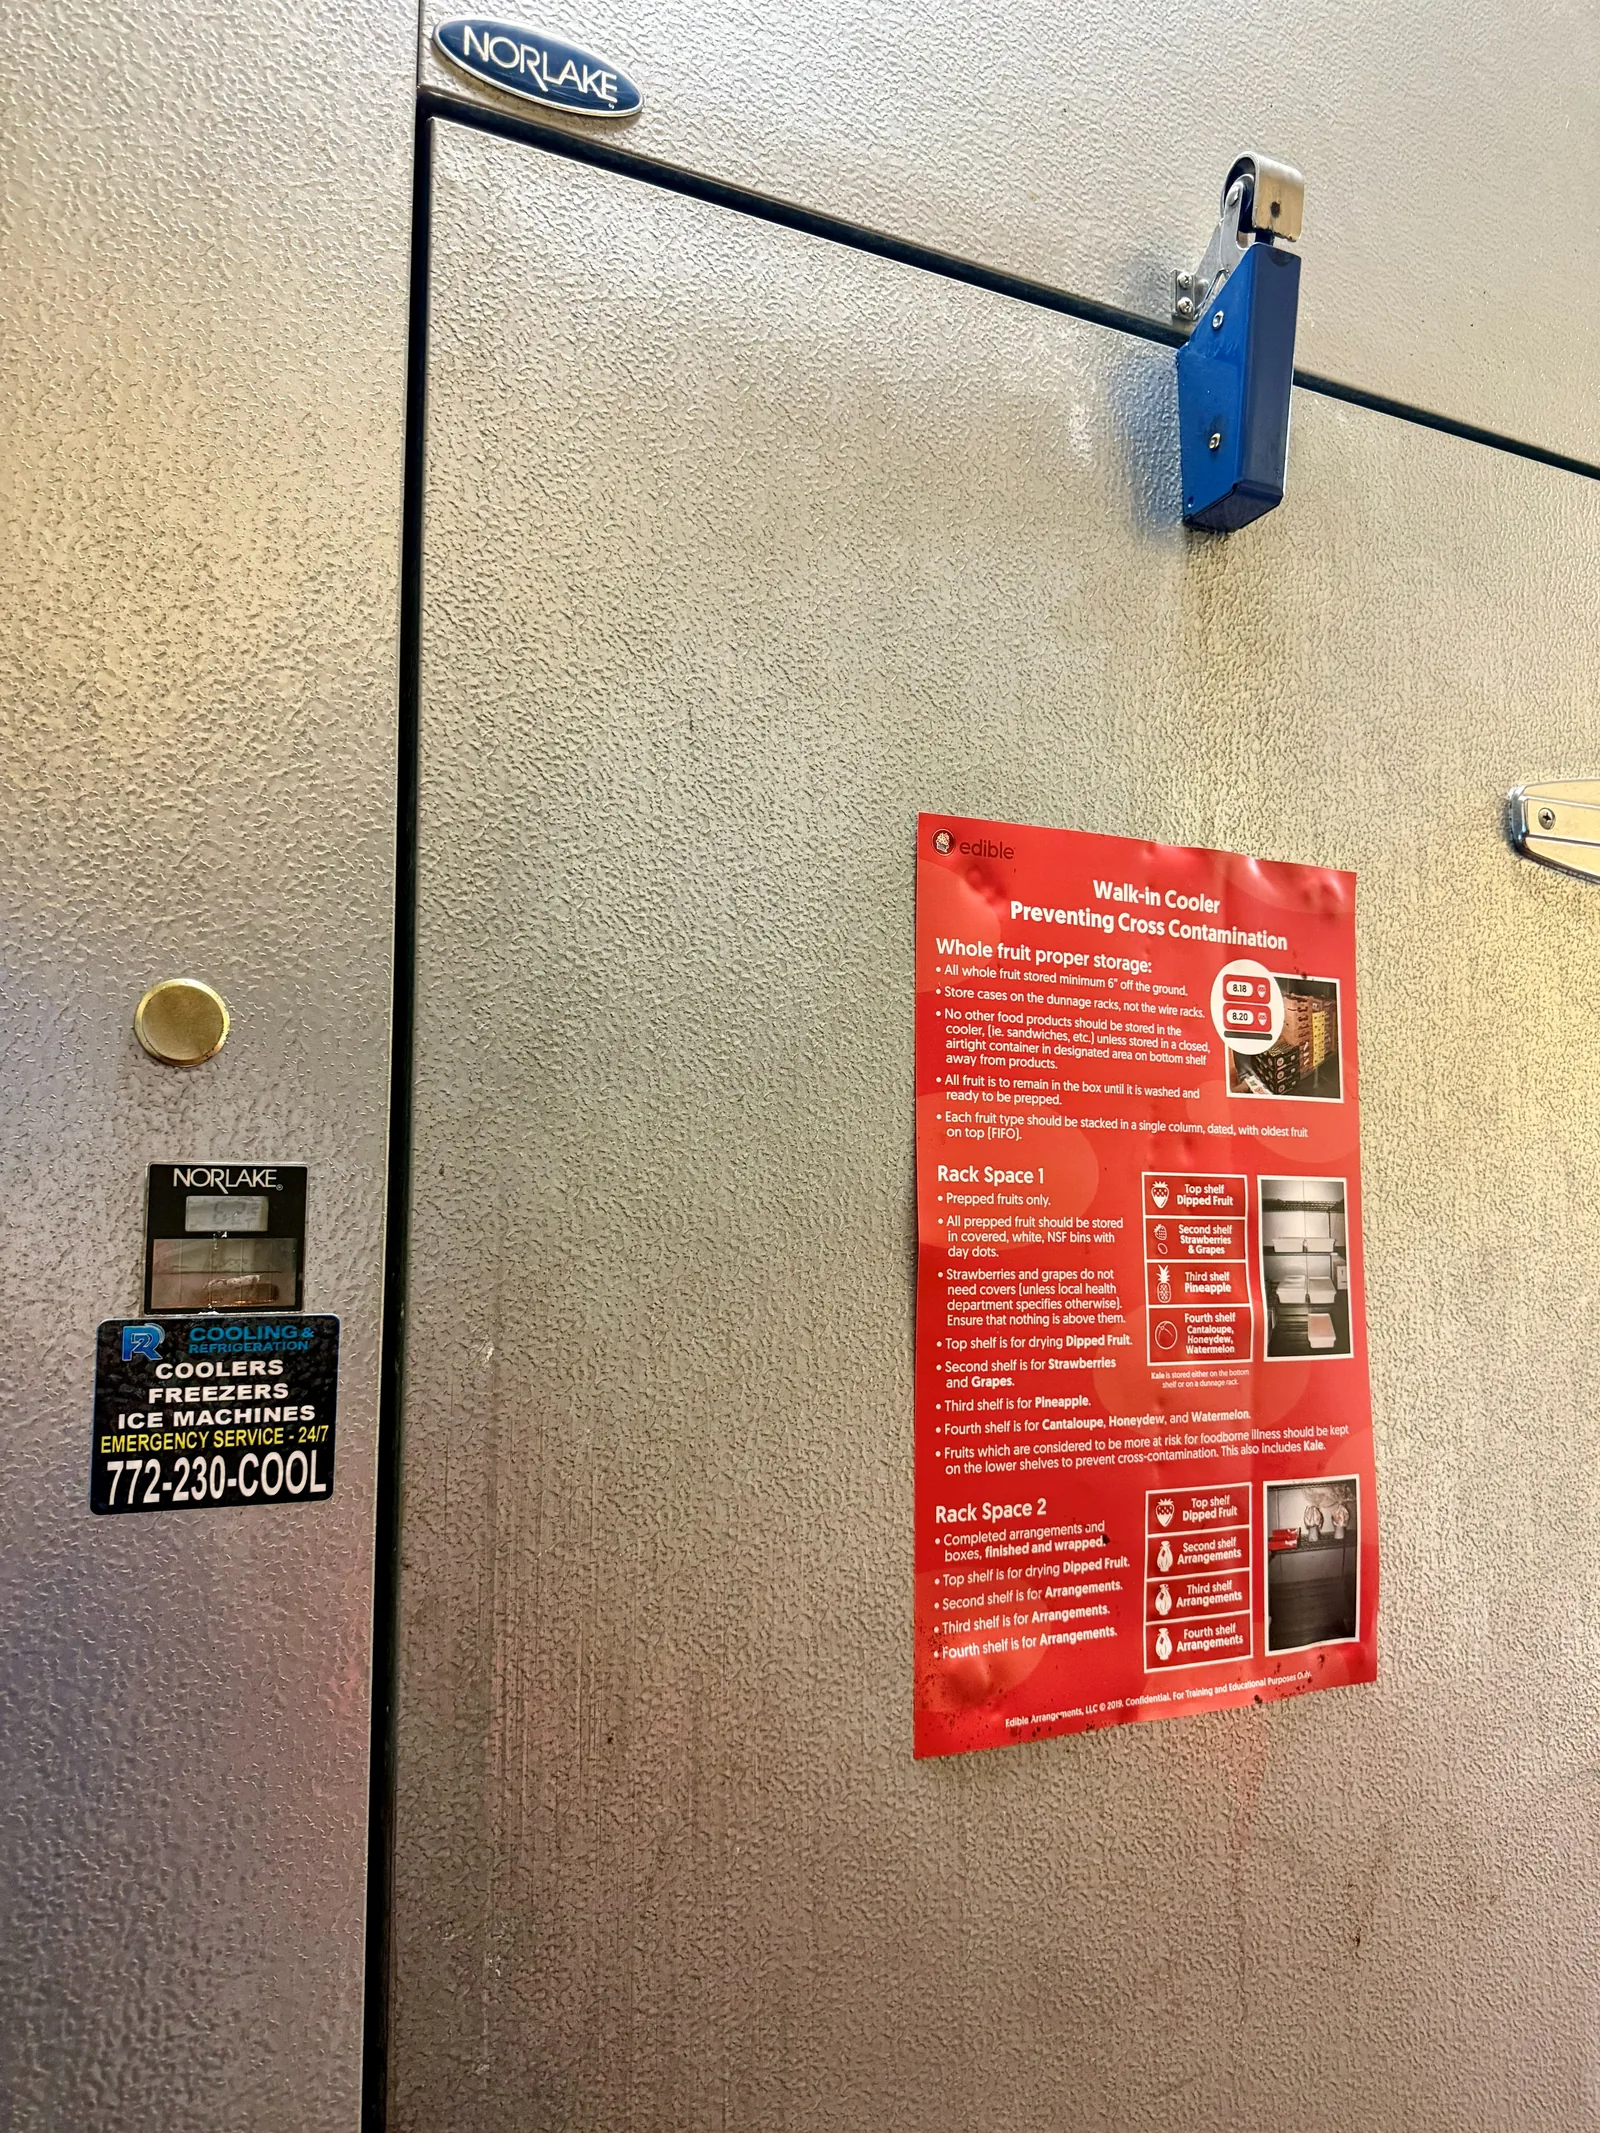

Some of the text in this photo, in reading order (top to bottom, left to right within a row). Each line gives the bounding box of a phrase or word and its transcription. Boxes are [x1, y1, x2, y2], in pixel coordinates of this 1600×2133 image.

[463, 25, 618, 104] NORLAKE
[959, 838, 1015, 860] edible
[1093, 880, 1220, 914] Walk-in Cooler
[1011, 901, 1287, 950] Preventing Cross Contamination
[936, 939, 1152, 975] Whole fruit proper storage:
[944, 964, 958, 975] All
[962, 965, 997, 978] whole
[999, 968, 1021, 980] fruit
[1023, 971, 1056, 983] stored
[1060, 974, 1105, 987] minimum
[1120, 979, 1134, 990] off
[1135, 981, 1150, 992] the
[1152, 984, 1188, 996] ground.
[1232, 984, 1247, 993] 8.18
[944, 986, 1205, 1018] Store cases on the dunnage racks, not the wire racks.
[1232, 1012, 1248, 1021] 8.20
[946, 1090, 1062, 1106] ready to be prepped.
[173, 1168, 278, 1194] NORLAKE
[938, 1165, 1043, 1187] Rack Space 1
[1184, 1184, 1224, 1197] Top shelf
[946, 1192, 1051, 1208] Prepped fruits only.
[1177, 1194, 1233, 1207] Dipped Fruit
[1178, 1224, 1232, 1234] Second shelf
[1180, 1235, 1232, 1244] Strawberries
[1188, 1244, 1225, 1256] & Grapes
[946, 1268, 1114, 1282] Strawberries and grapes do not
[1185, 1271, 1230, 1281] Third shelf
[1184, 1282, 1232, 1295] Pineapple
[947, 1312, 1126, 1327] Ensure that nothing is above them.
[1184, 1312, 1236, 1323] Fourth shelf
[189, 1325, 298, 1341] COOLING
[1187, 1324, 1234, 1337] Cantaloupe,
[189, 1340, 309, 1353] REFRIGERATION
[945, 1334, 1133, 1352] Top shelf is for drying Dipped Fruit.
[1186, 1344, 1235, 1354] Watermelon
[1187, 1334, 1233, 1347] Honeydew,
[155, 1359, 284, 1380] COOLERS
[945, 1356, 1116, 1373] Second shelf is for Strawberries
[946, 1376, 1015, 1390] and Grapes.
[149, 1383, 289, 1403] FREEZERS
[944, 1394, 1091, 1412] Third shelf is for Pineapple.
[118, 1405, 315, 1429] ICE MACHINES
[945, 1409, 1251, 1435] Fourth shelf is for Cantaloupe, Honeydew, and Watermelon.
[101, 1431, 209, 1453] EMERGENCY
[213, 1427, 284, 1447] SERVICE
[298, 1425, 329, 1443] 24/7
[107, 1450, 327, 1505] 772-230-COOL
[936, 1498, 1046, 1523] Rack Space 2
[1191, 1495, 1230, 1510] Top shelf
[1183, 1505, 1237, 1522] Dipped Fruit
[944, 1520, 1105, 1546] Completed arrangements and
[945, 1536, 1106, 1562] boxes, finished and wrapped.
[1183, 1536, 1236, 1553] Second shelf
[1177, 1548, 1242, 1565] Arrangements
[943, 1580, 1123, 1611] Second shelf is for Arrangements.
[1187, 1580, 1232, 1595] Third shelf
[1176, 1591, 1242, 1608] Arrangements
[1184, 1622, 1236, 1639] Fourth shelf
[942, 1626, 1117, 1659] Fourth shelf is for Arrangements.
[1177, 1634, 1244, 1652] Arrangements
[1085, 1678, 1266, 1714] LLC 2019. Confidential. For Training and Educational
